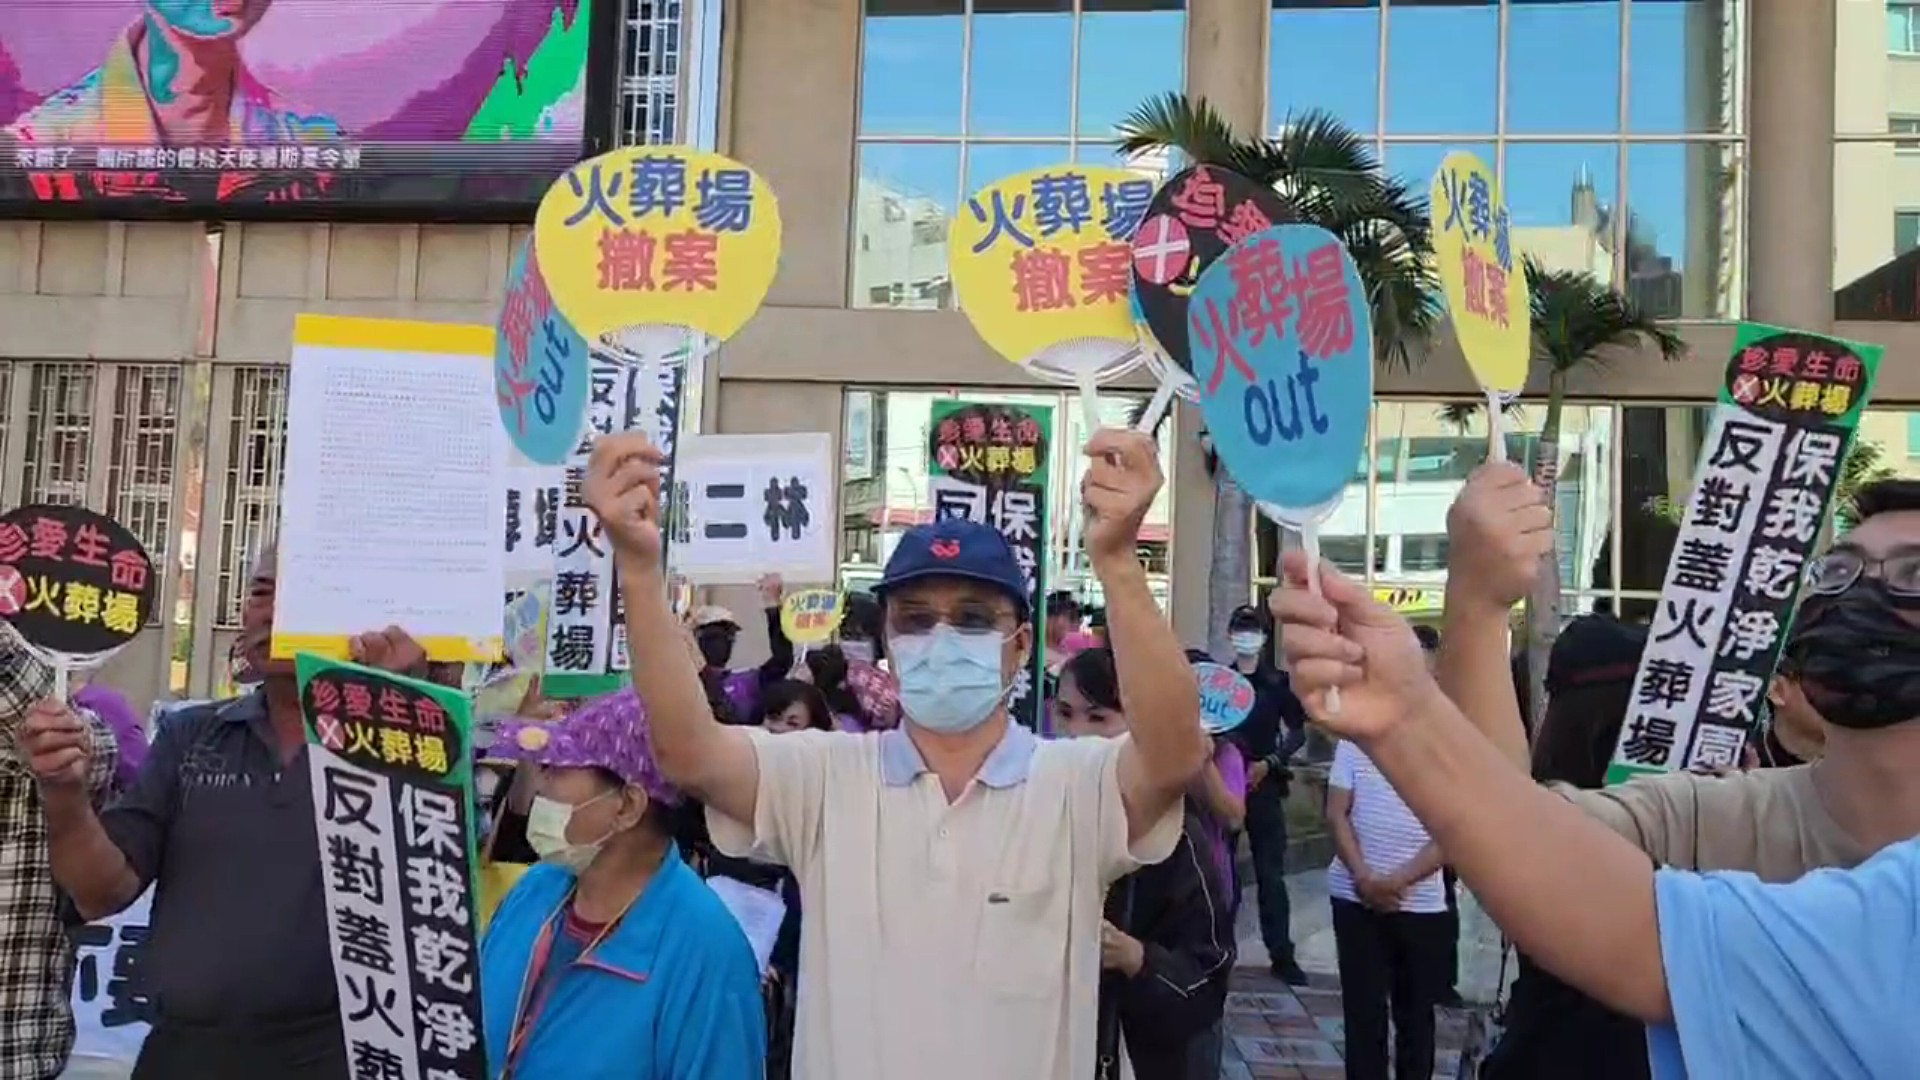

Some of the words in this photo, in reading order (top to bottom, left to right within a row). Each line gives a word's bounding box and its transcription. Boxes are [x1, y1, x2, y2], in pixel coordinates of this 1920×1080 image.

[563, 153, 754, 232] 火葬場
[967, 172, 1154, 253] 火葬場
[1439, 167, 1513, 274] 火葬場
[597, 228, 719, 292] 撤案
[1009, 241, 1132, 312] 撤案
[1191, 239, 1355, 396] 火葬場
[534, 317, 570, 426] out
[1243, 350, 1329, 447] out
[1739, 346, 1862, 383] 珍愛生命
[1761, 378, 1852, 414] 火葬場
[25, 575, 142, 634] 火葬場
[1622, 420, 1773, 766] 反對蓋火葬場
[1688, 428, 1842, 768] 保我乾淨家園
[311, 678, 448, 732] 珍愛生命
[345, 723, 448, 774] 火葬場
[397, 782, 477, 1080] 保我乾淨
